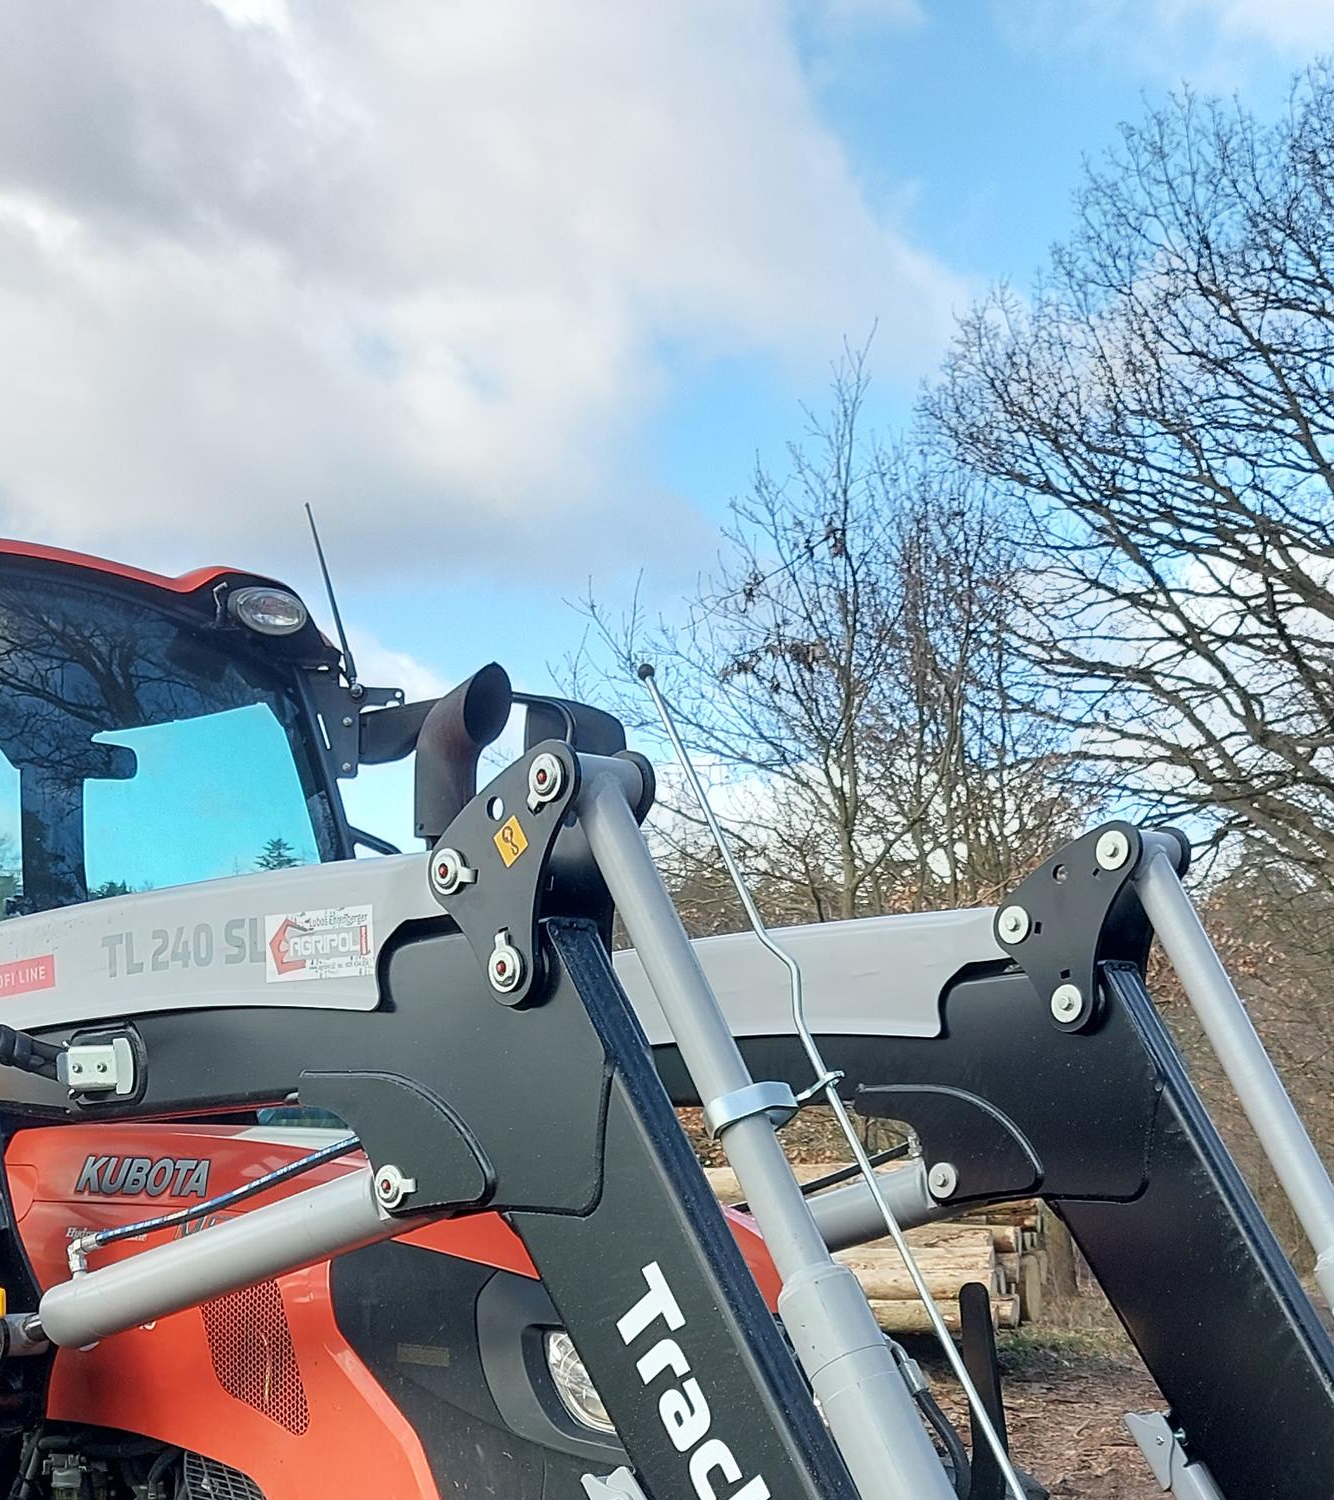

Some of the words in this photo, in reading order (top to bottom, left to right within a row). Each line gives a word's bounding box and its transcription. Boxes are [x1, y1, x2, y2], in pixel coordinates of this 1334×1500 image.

[101, 931, 144, 978] TL
[151, 922, 215, 972] 240
[289, 932, 360, 957] AGRIPOL
[18, 964, 47, 985] LINE
[74, 1155, 211, 1198] KUBOTA
